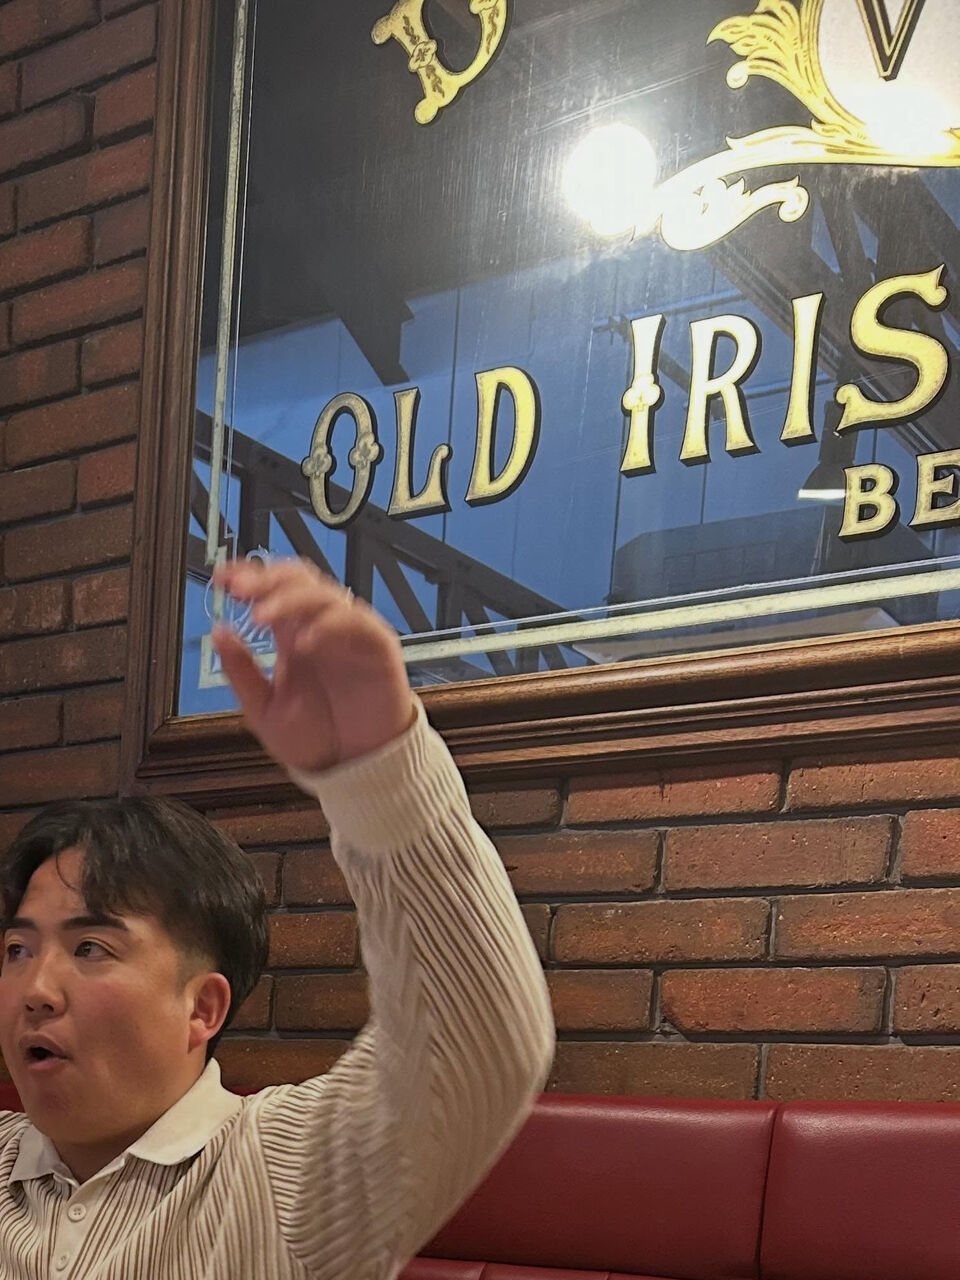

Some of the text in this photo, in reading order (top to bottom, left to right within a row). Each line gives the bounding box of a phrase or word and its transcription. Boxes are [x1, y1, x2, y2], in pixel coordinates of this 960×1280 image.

[301, 263, 952, 530] OLD IRIS
[838, 448, 960, 543] BE
